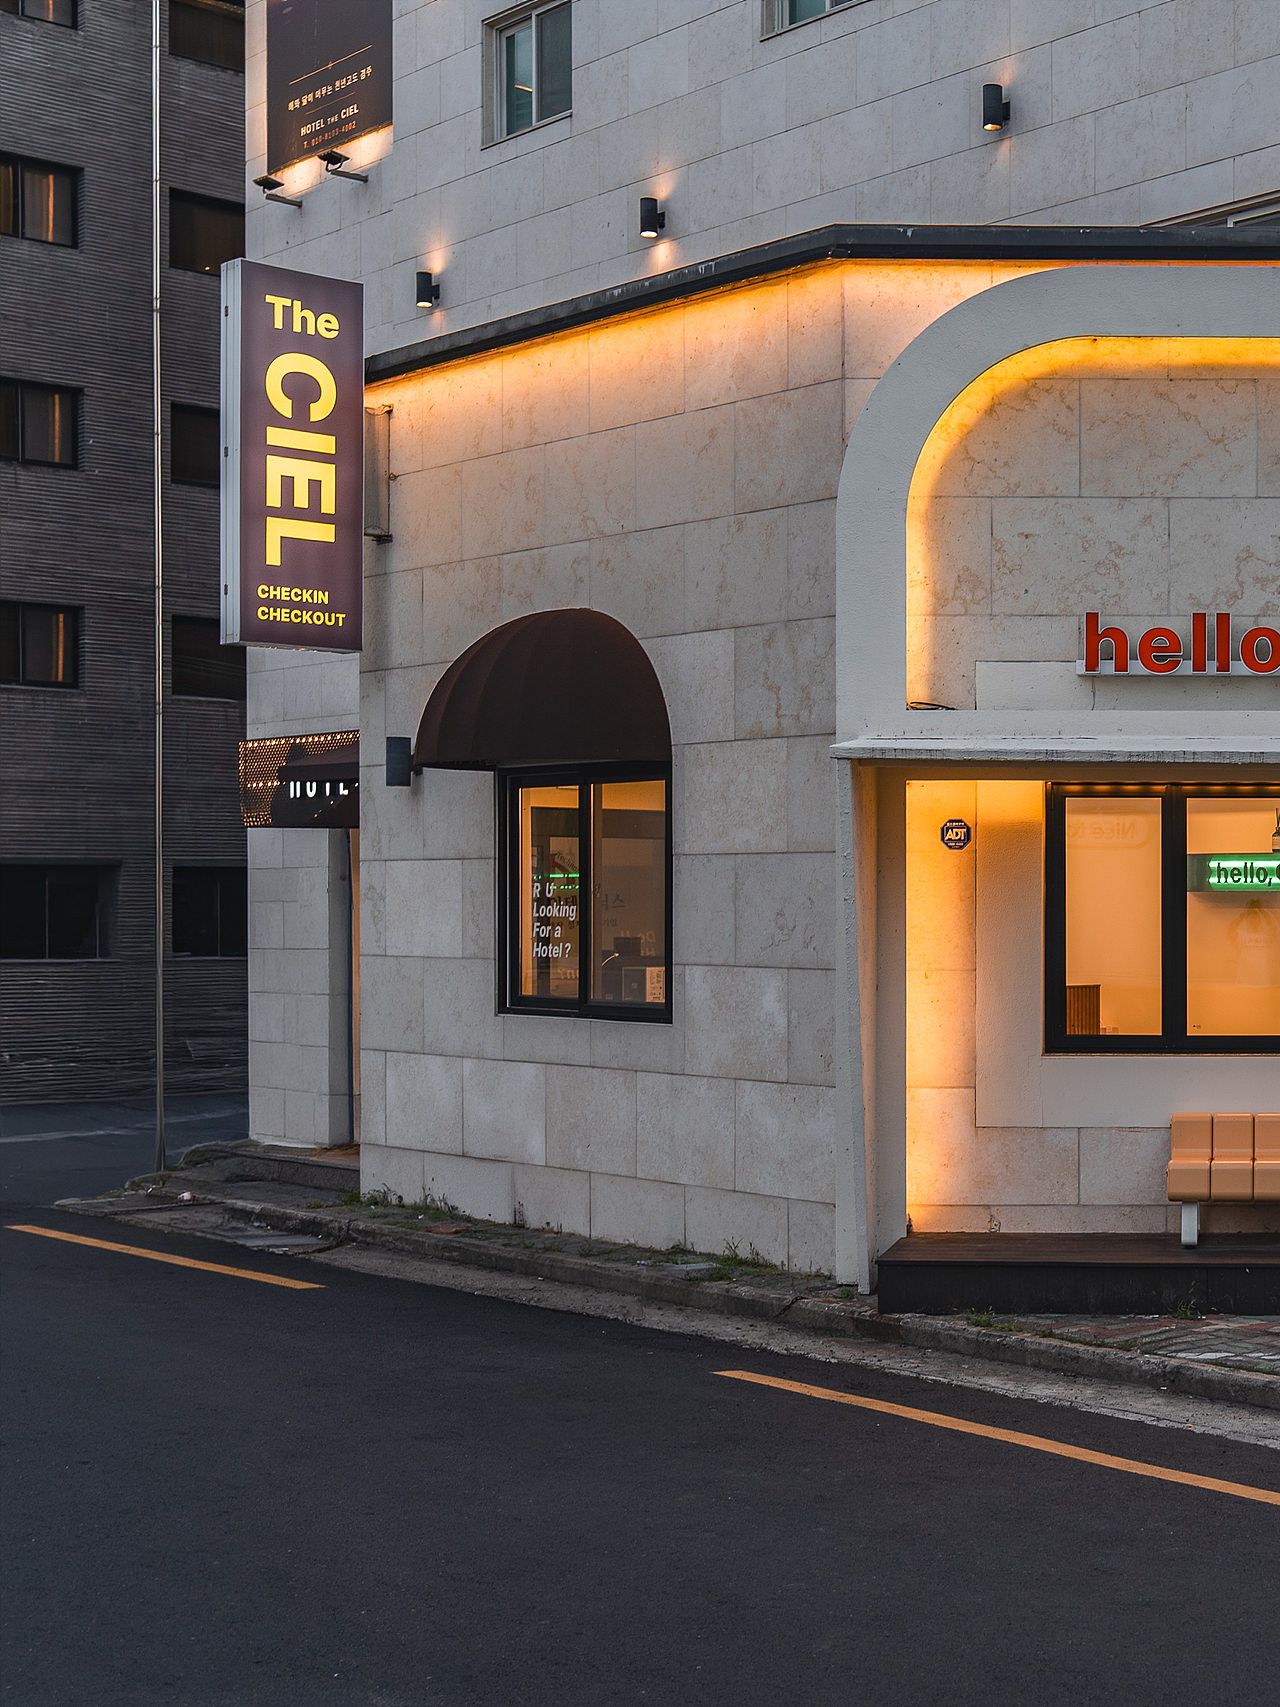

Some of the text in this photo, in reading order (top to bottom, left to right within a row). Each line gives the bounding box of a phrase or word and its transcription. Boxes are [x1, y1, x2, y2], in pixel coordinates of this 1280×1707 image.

[300, 103, 360, 137] HOTEL THE CIEL
[265, 294, 340, 339] The
[265, 352, 337, 567] CIEL
[257, 584, 329, 605] CHECKIN
[257, 606, 347, 627] CHECKOUT
[944, 828, 966, 840] ADT
[1216, 862, 1272, 887] hello,
[533, 882, 554, 898] R U
[533, 902, 577, 921] Looking
[533, 922, 551, 938] For
[554, 925, 561, 938] a
